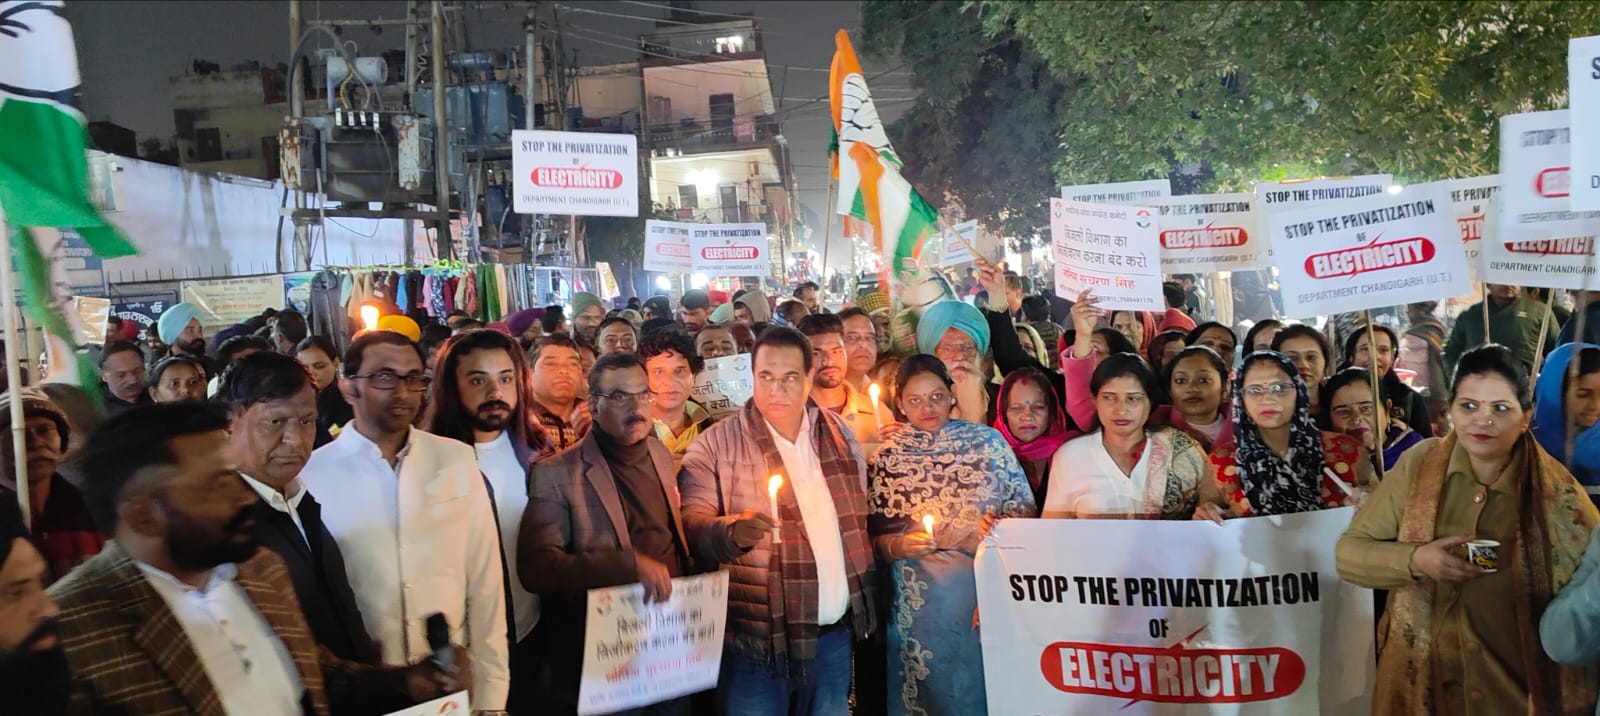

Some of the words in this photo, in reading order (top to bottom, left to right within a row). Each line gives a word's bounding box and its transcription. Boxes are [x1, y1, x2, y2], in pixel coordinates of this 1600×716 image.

[522, 140, 545, 152] STOP
[547, 141, 562, 153] THE
[565, 142, 628, 155] PRIVATIZATION
[537, 167, 616, 189] ELECTRICITY
[522, 195, 567, 204] DEPARTMENT
[1093, 193, 1106, 203] THE
[1265, 191, 1290, 204] STOP
[1293, 190, 1310, 202] THE
[1312, 184, 1383, 201] PRIVATIZATION
[1450, 190, 1461, 203] HE
[1189, 201, 1250, 215] PRIVATIZATION
[1284, 221, 1314, 240] STOP
[1316, 216, 1341, 233] THE
[1342, 199, 1436, 230] PRIVATIZATION
[693, 230, 707, 239] STOP
[709, 230, 720, 238] THE
[720, 229, 761, 238] PRIVATIZATION
[1084, 227, 1111, 247] विभाग
[1114, 235, 1128, 249] का
[1165, 229, 1241, 248] ELECTRICITY
[1356, 231, 1367, 243] OF
[705, 247, 755, 259] ELECTRICITY
[1082, 249, 1105, 265] करना
[1108, 250, 1123, 267] बंद
[1125, 251, 1147, 269] करो
[1159, 256, 1195, 265] PARTMENT
[1312, 239, 1425, 279] ELECTRICITY
[1490, 261, 1543, 273] DEPARTMENT
[1297, 286, 1359, 305] DEPARTMENT
[1360, 276, 1425, 295] CHANDIGARH
[1009, 572, 1069, 603] STOP
[1074, 576, 1120, 606] THE
[1125, 571, 1320, 608] PRIVATIZATION
[1149, 617, 1169, 639] OF
[1058, 647, 1280, 698] ELECTRICITY
